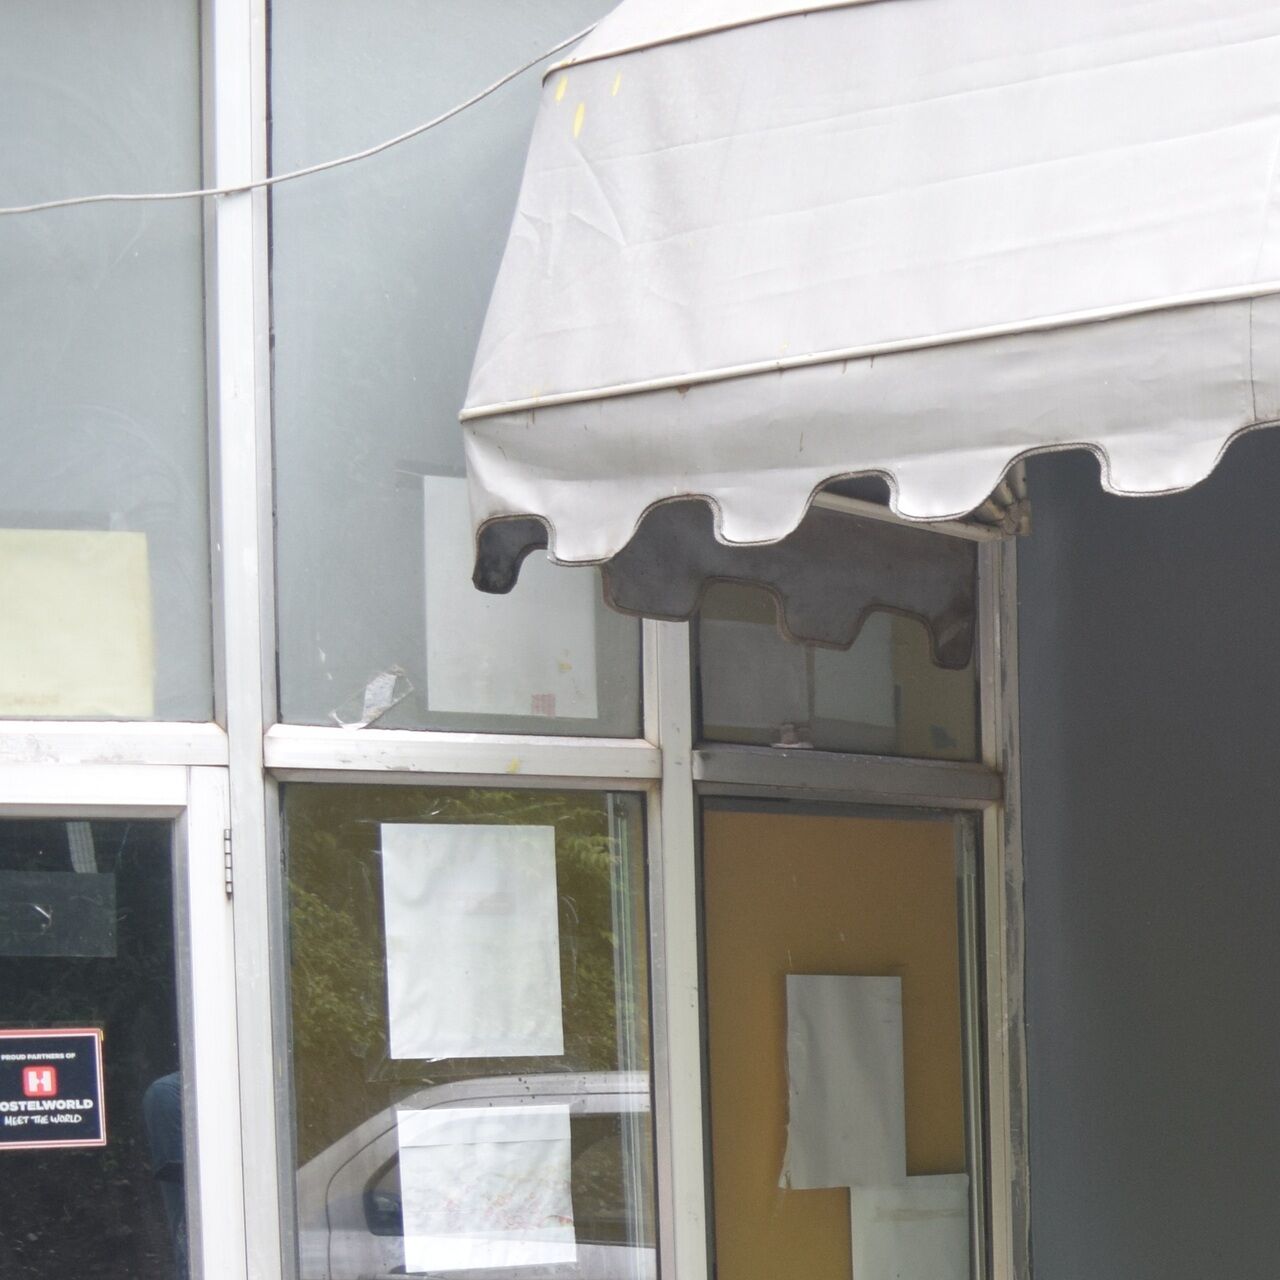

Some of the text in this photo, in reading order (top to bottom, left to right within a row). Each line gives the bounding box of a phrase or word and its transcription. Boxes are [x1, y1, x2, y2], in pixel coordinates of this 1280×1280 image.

[4, 1113, 82, 1126] MEET THE WORLD
